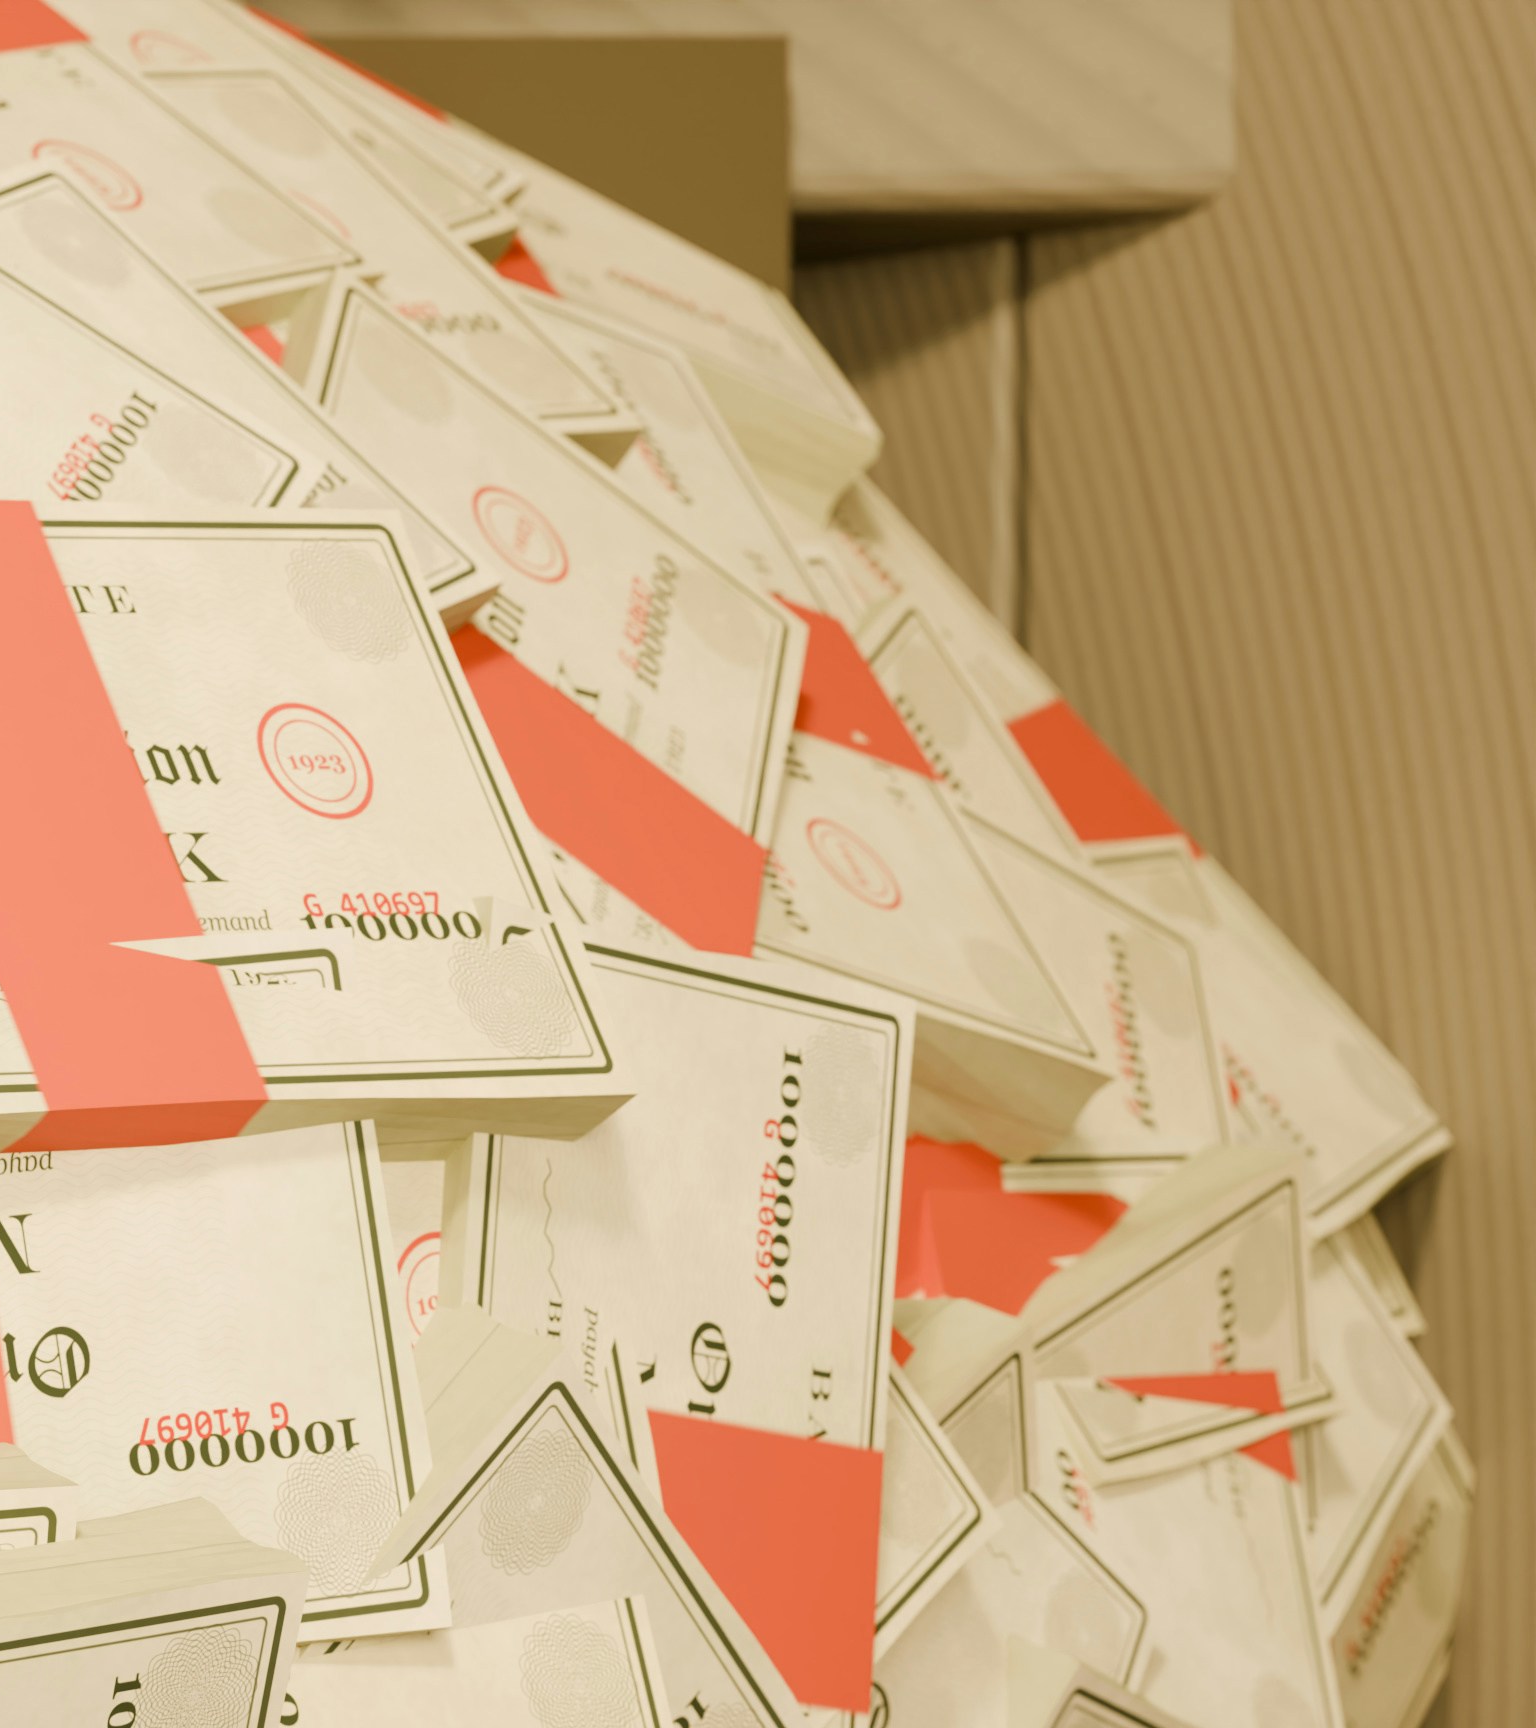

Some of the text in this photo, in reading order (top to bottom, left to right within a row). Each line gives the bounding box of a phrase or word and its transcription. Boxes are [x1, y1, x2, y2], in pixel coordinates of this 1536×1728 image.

[287, 754, 348, 775] 1923
[302, 890, 440, 919] G 410697
[754, 1118, 784, 1293] G 410697
[767, 1051, 804, 1309] 1000000
[128, 1417, 361, 1477] 1000000
[138, 1400, 290, 1448] G 410697
